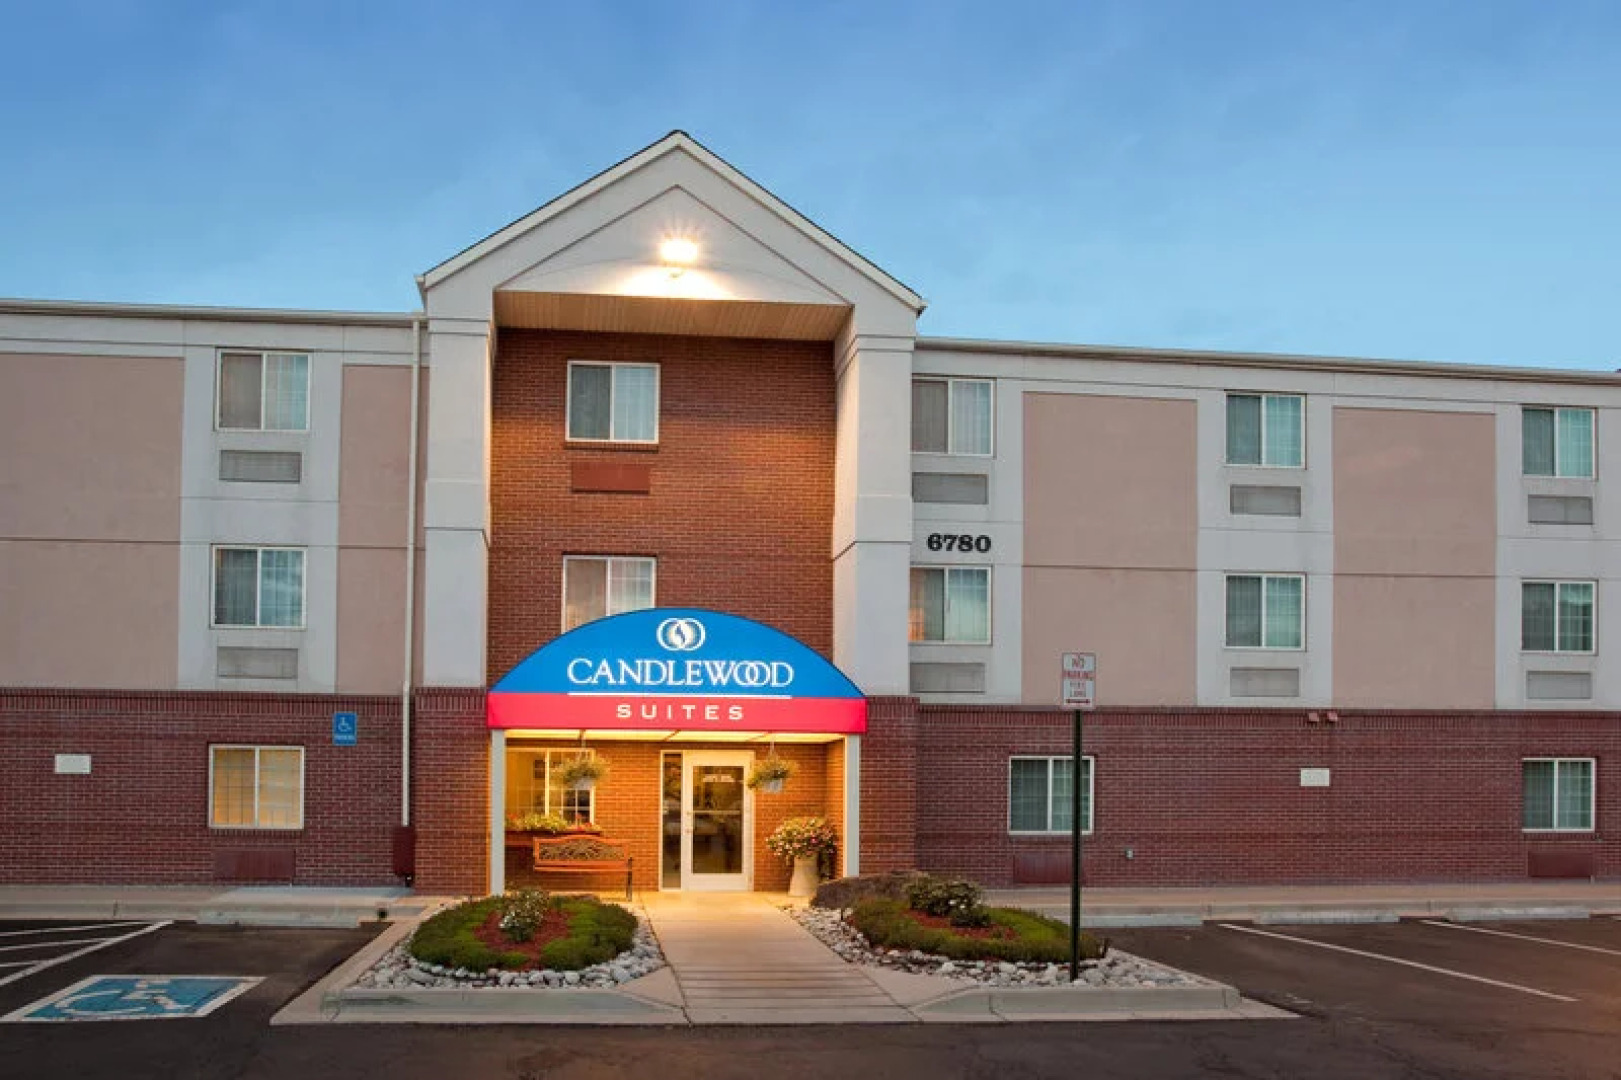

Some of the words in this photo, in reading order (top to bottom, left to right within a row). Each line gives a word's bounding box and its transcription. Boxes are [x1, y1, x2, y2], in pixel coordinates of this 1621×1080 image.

[926, 533, 992, 553] 6780
[566, 658, 795, 687] CANDLEWOOD
[616, 703, 744, 720] SUITES
